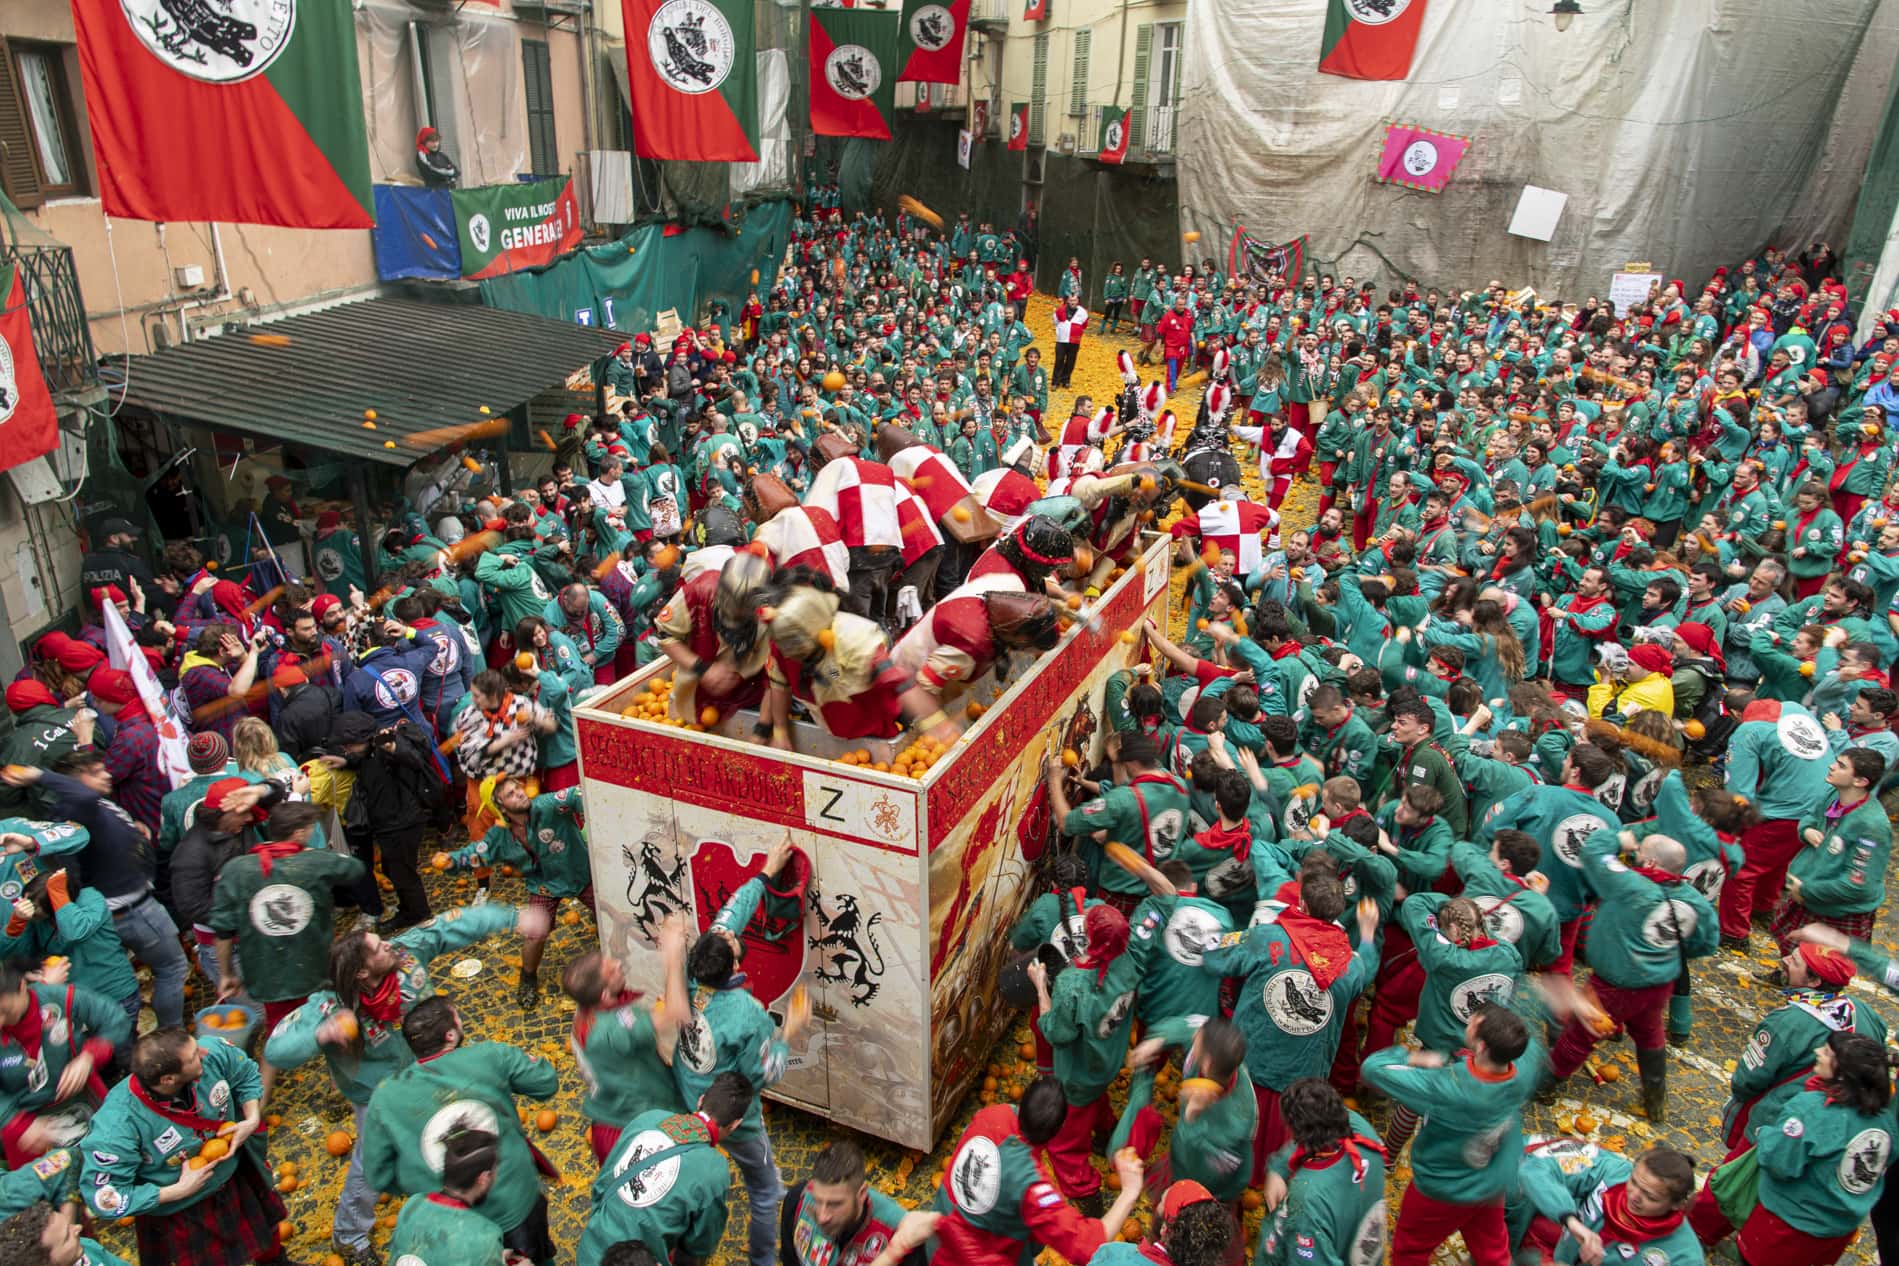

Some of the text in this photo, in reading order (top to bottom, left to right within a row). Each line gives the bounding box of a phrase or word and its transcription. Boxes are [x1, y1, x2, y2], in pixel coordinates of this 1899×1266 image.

[505, 207, 529, 221] VIVA
[530, 205, 539, 219] IL
[83, 569, 122, 582] POLIZIA
[820, 785, 845, 822] Z
